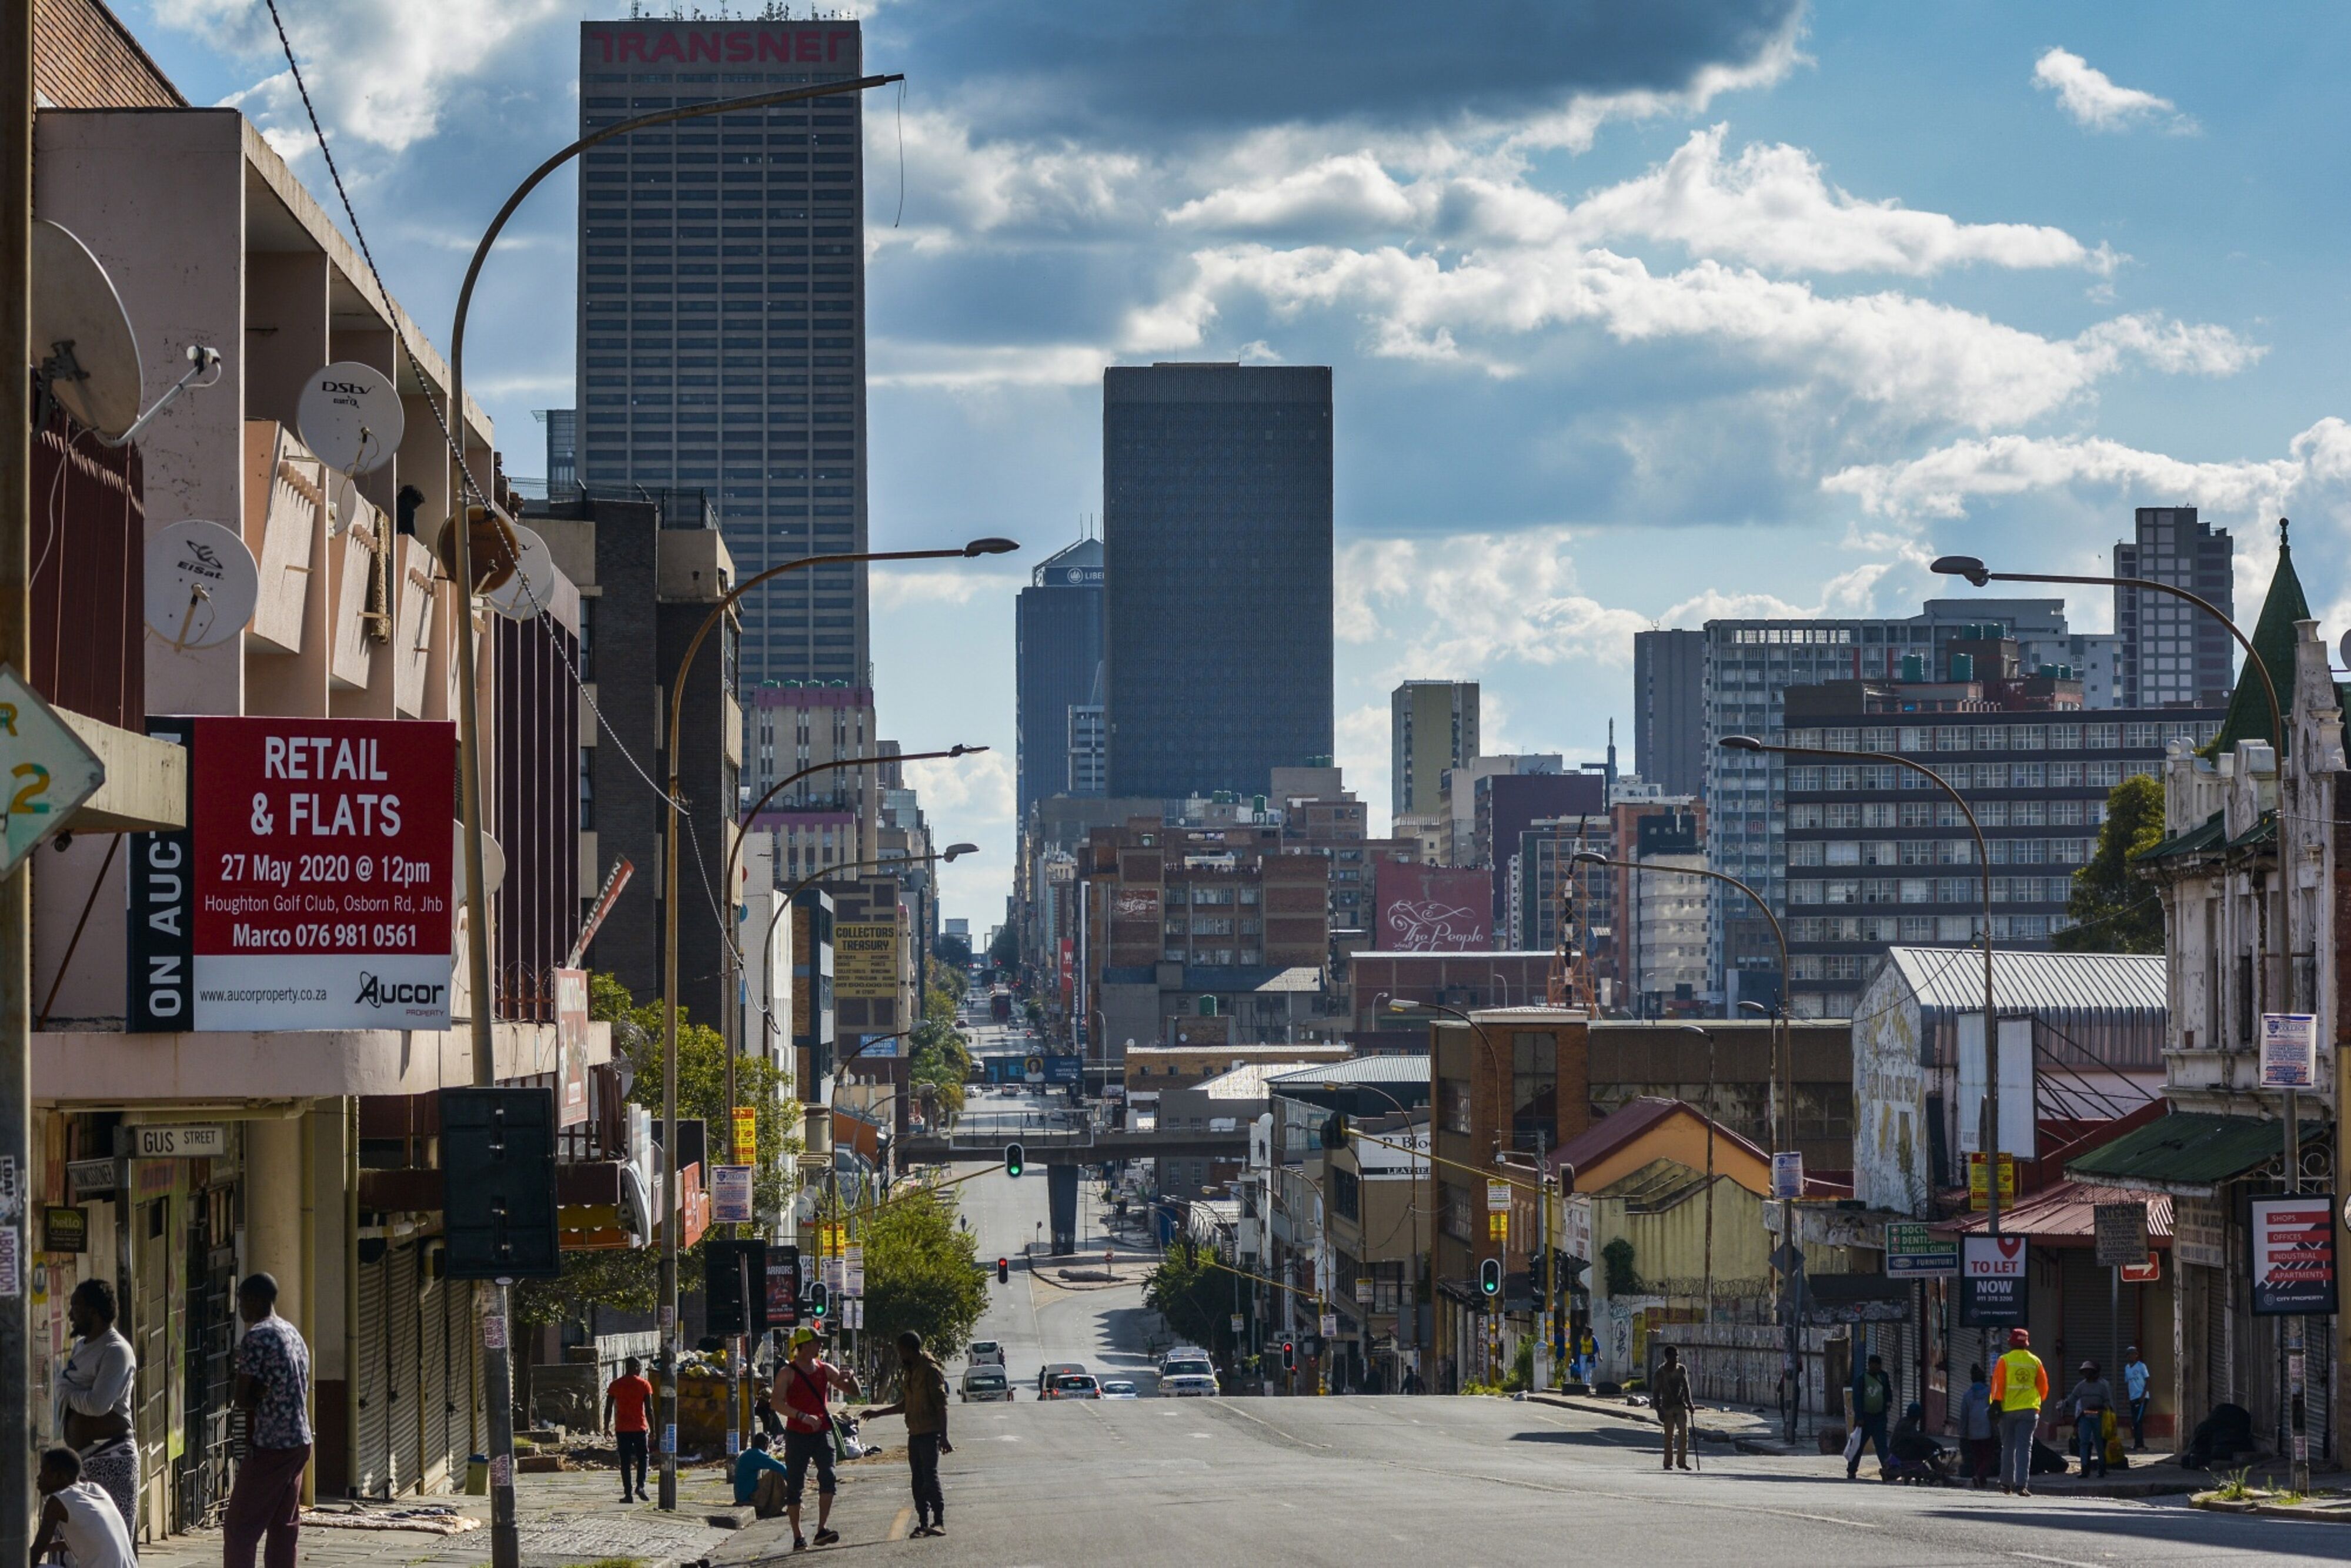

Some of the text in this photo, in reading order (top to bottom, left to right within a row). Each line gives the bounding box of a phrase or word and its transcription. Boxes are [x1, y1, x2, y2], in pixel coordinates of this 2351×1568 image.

[591, 31, 850, 63] TRANSNET
[265, 736, 388, 781] RETAIL
[251, 792, 401, 837] & FLATS
[221, 854, 430, 888] 27 May 2020 @ 12pm
[205, 895, 443, 915] Houghton Golf Club, Osborn Rd, Jhb
[582, 861, 622, 937] AUCTION
[232, 923, 417, 947] Marco 076 981 0561
[836, 927, 894, 938] COLLECTORS
[1430, 921, 1484, 952] People
[841, 940, 890, 951] TREASURY
[149, 955, 182, 1018] ON
[200, 987, 327, 1005] www.aucorproperty.co.za
[355, 972, 445, 1007] Aucor
[406, 1008, 445, 1017] PROPERTY
[143, 1130, 216, 1154] GUS STREET
[51, 1216, 80, 1229] hello
[1902, 1245, 1953, 1254] TRAVEL CLINIC
[2273, 1252, 2316, 1260] INDUSTRIAL
[1916, 1258, 1954, 1266] FURNITURE
[1971, 1261, 2018, 1273] TO LET
[2274, 1270, 2324, 1279] APARTMENTS
[1976, 1280, 2013, 1294] NOW
